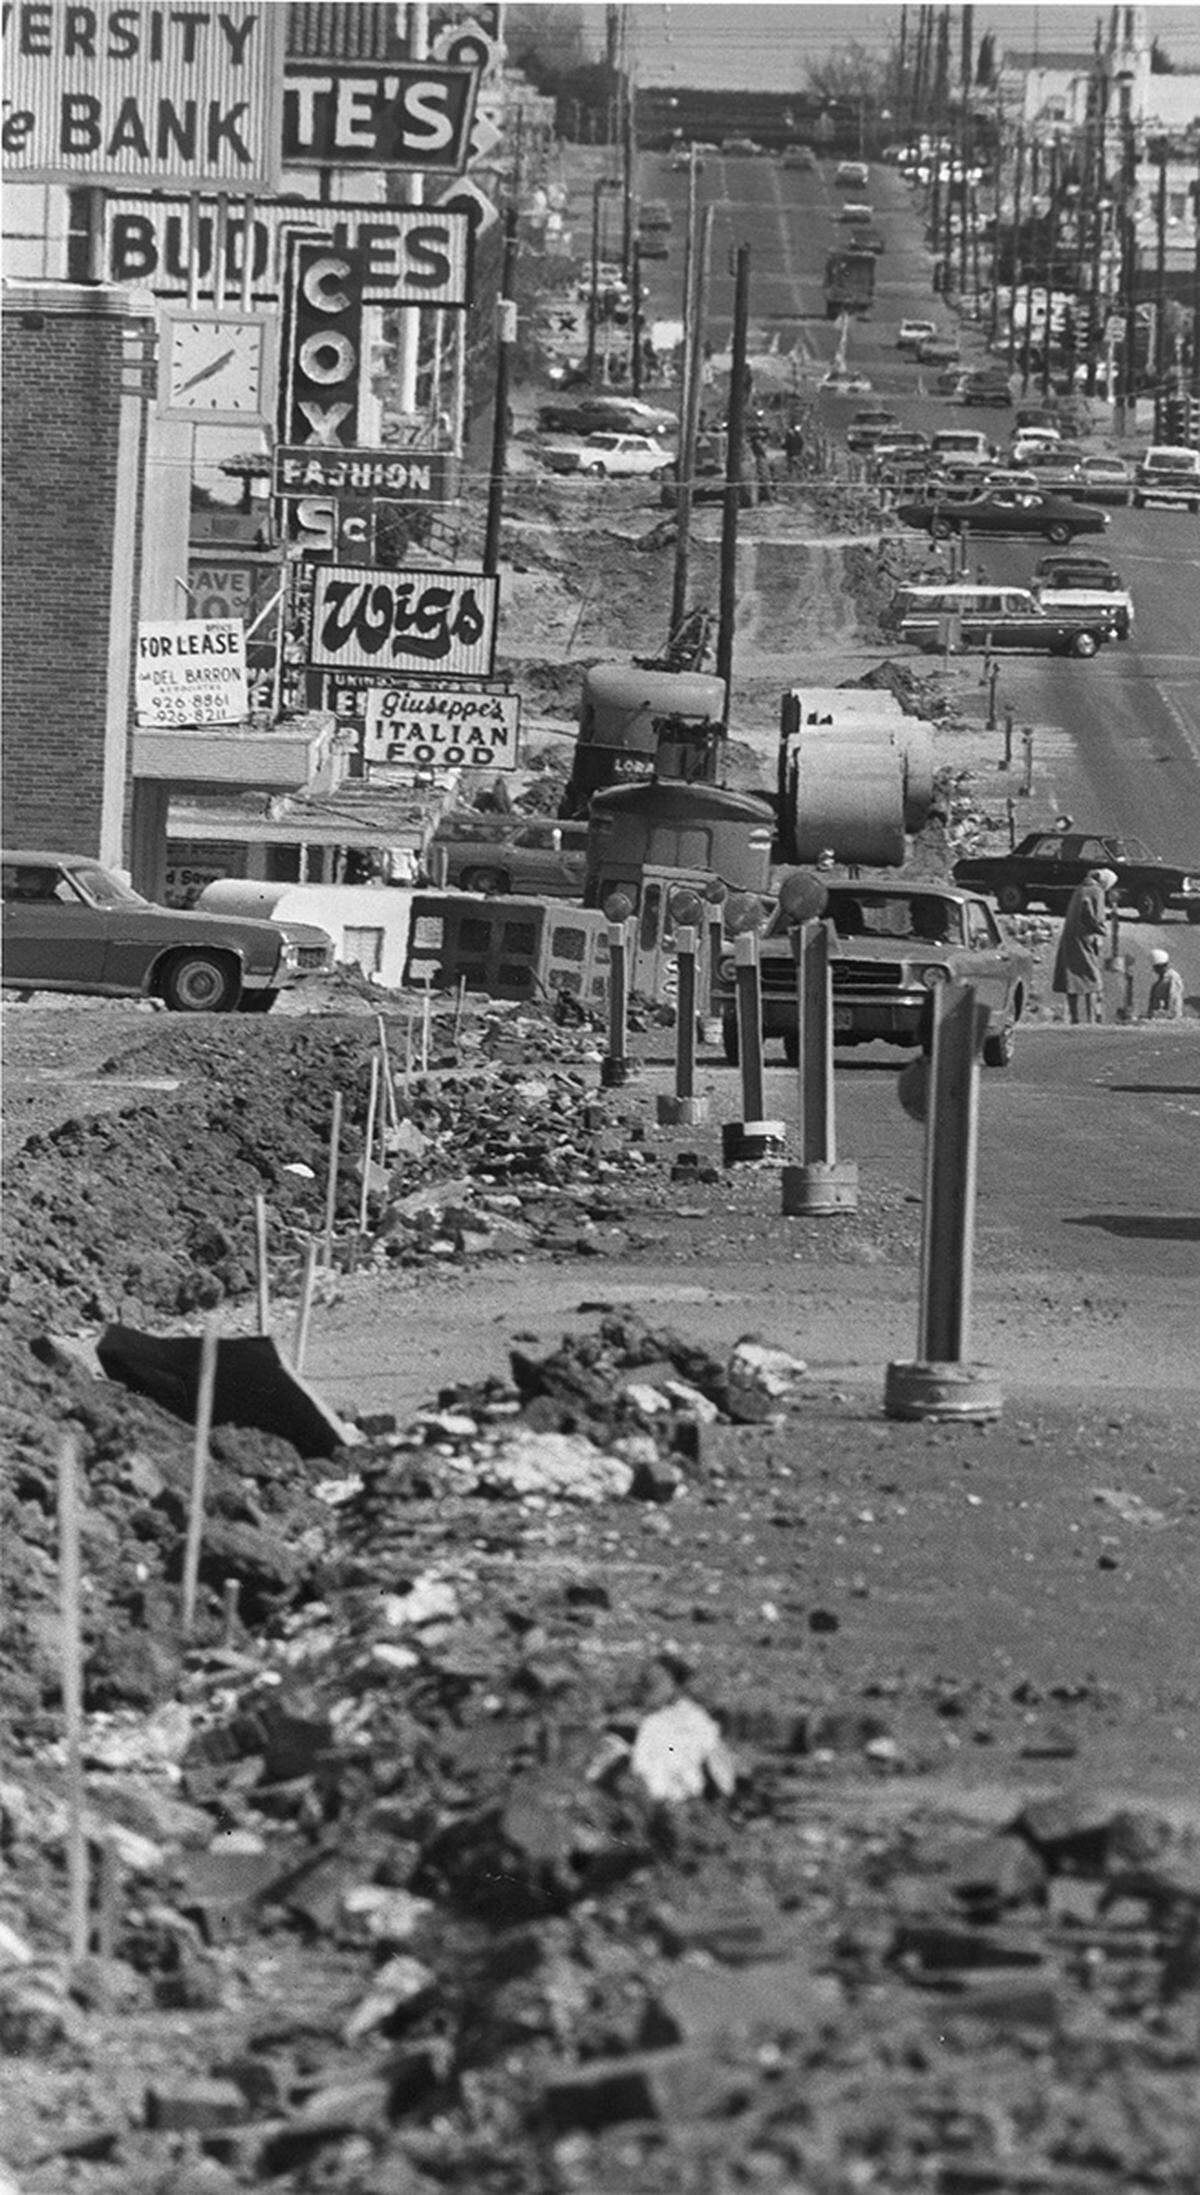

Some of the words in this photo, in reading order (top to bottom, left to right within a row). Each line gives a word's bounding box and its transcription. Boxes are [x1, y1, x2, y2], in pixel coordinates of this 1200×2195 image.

[2, 4, 258, 65] ERSITY
[60, 93, 252, 163] BANK
[283, 458, 431, 490] FASHION
[321, 580, 484, 661] Wigs
[140, 636, 172, 658] FOR
[177, 633, 239, 655] LEASE
[153, 669, 178, 685] DEL
[185, 667, 241, 683] BARRON
[381, 691, 507, 722] Giuseppe's
[376, 720, 508, 746] ITALIAN
[387, 743, 495, 766] FOOD
